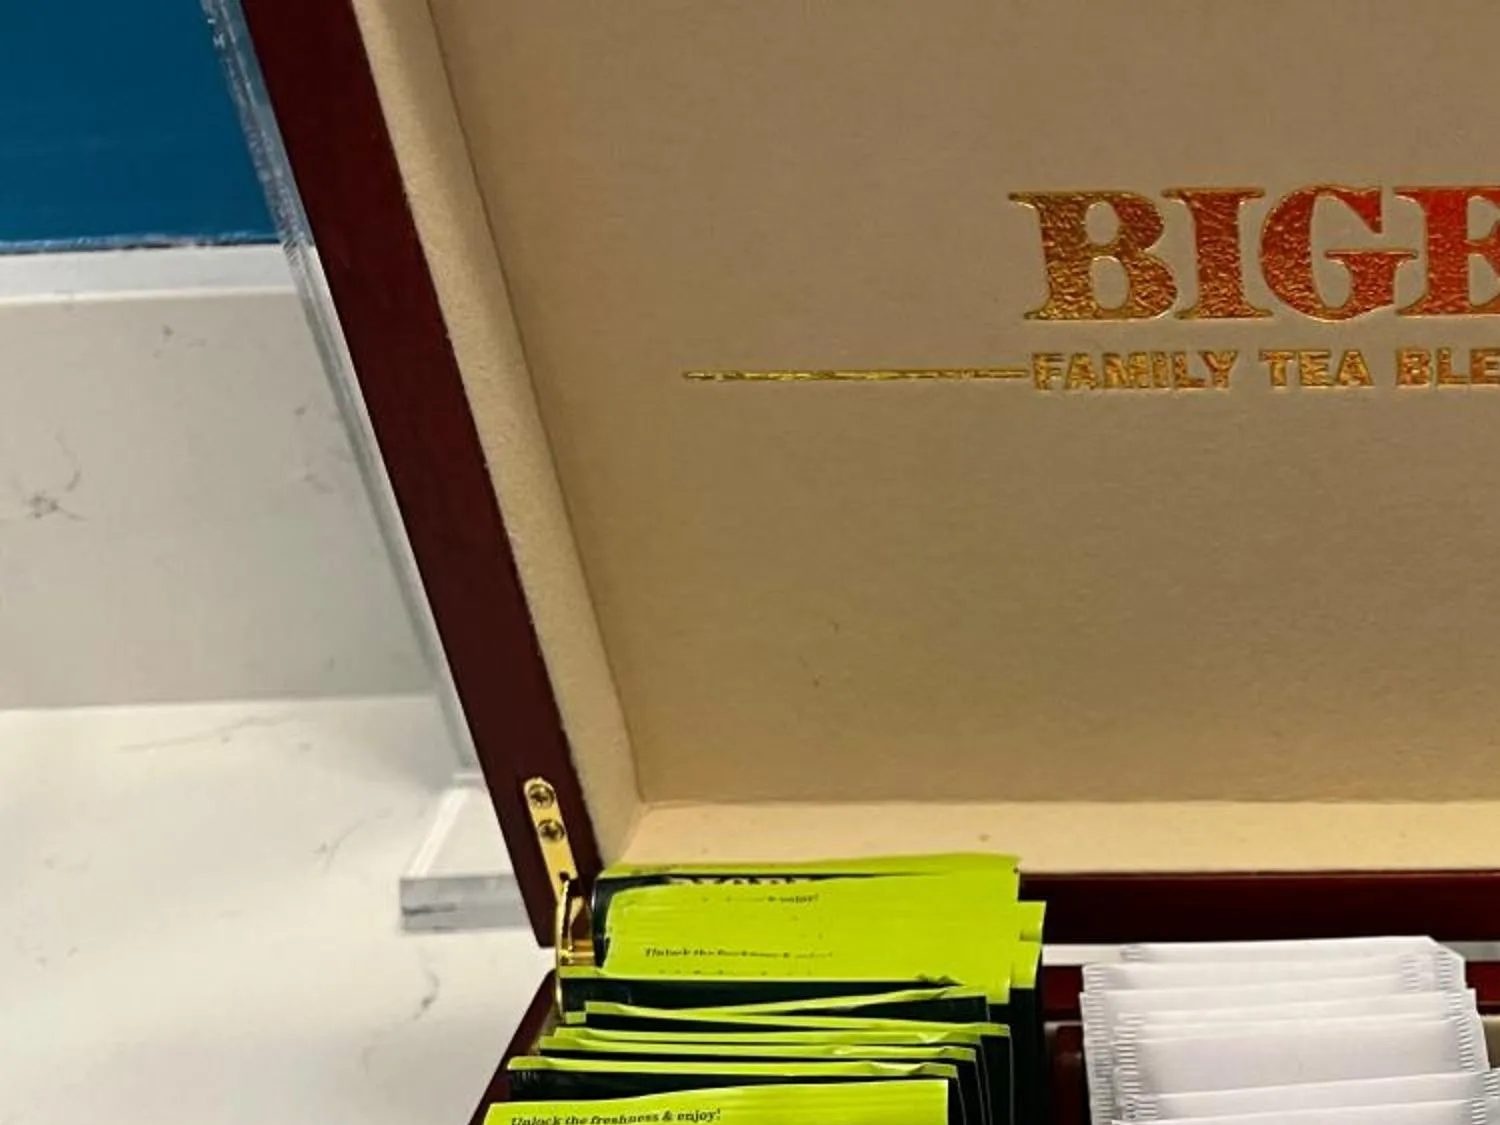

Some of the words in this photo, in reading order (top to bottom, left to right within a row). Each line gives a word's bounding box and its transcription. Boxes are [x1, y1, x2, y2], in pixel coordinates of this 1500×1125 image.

[1032, 350, 1238, 390] FAMILY
[1260, 349, 1371, 387] TEA
[565, 1116, 587, 1125] the
[590, 1114, 659, 1125] freshness
[677, 1108, 721, 1123] enjoy!
